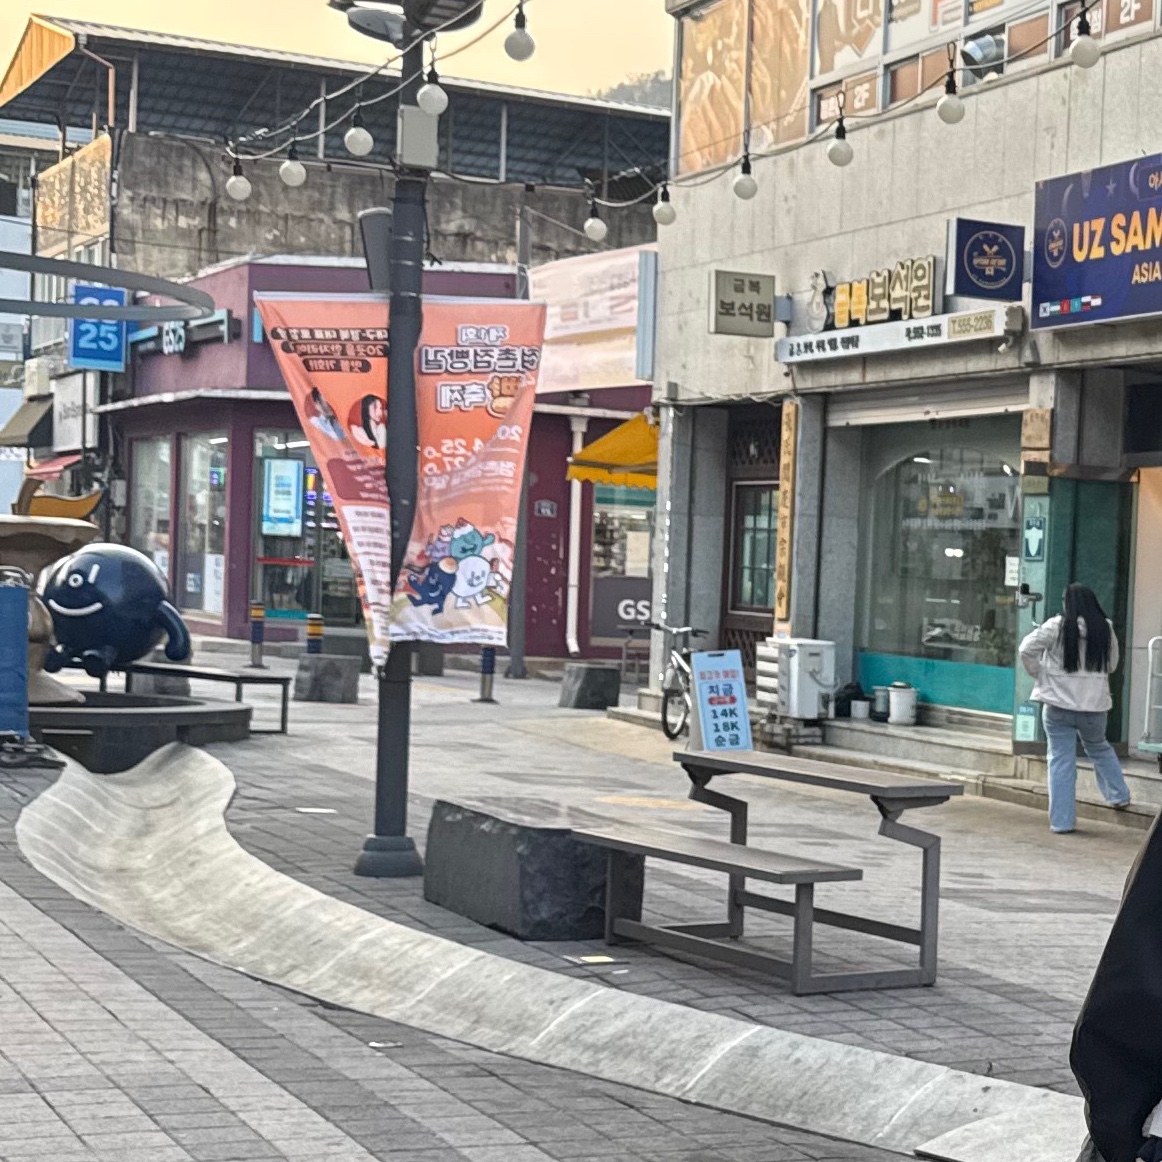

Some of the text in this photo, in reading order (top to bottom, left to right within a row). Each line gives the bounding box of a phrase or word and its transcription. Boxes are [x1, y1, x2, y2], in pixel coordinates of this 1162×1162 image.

[1072, 217, 1106, 263] UZ
[1132, 260, 1162, 285] ASIA
[719, 300, 771, 322] 보석원
[79, 323, 119, 350] 25
[711, 707, 738, 719] 14K
[713, 721, 740, 732] 18K
